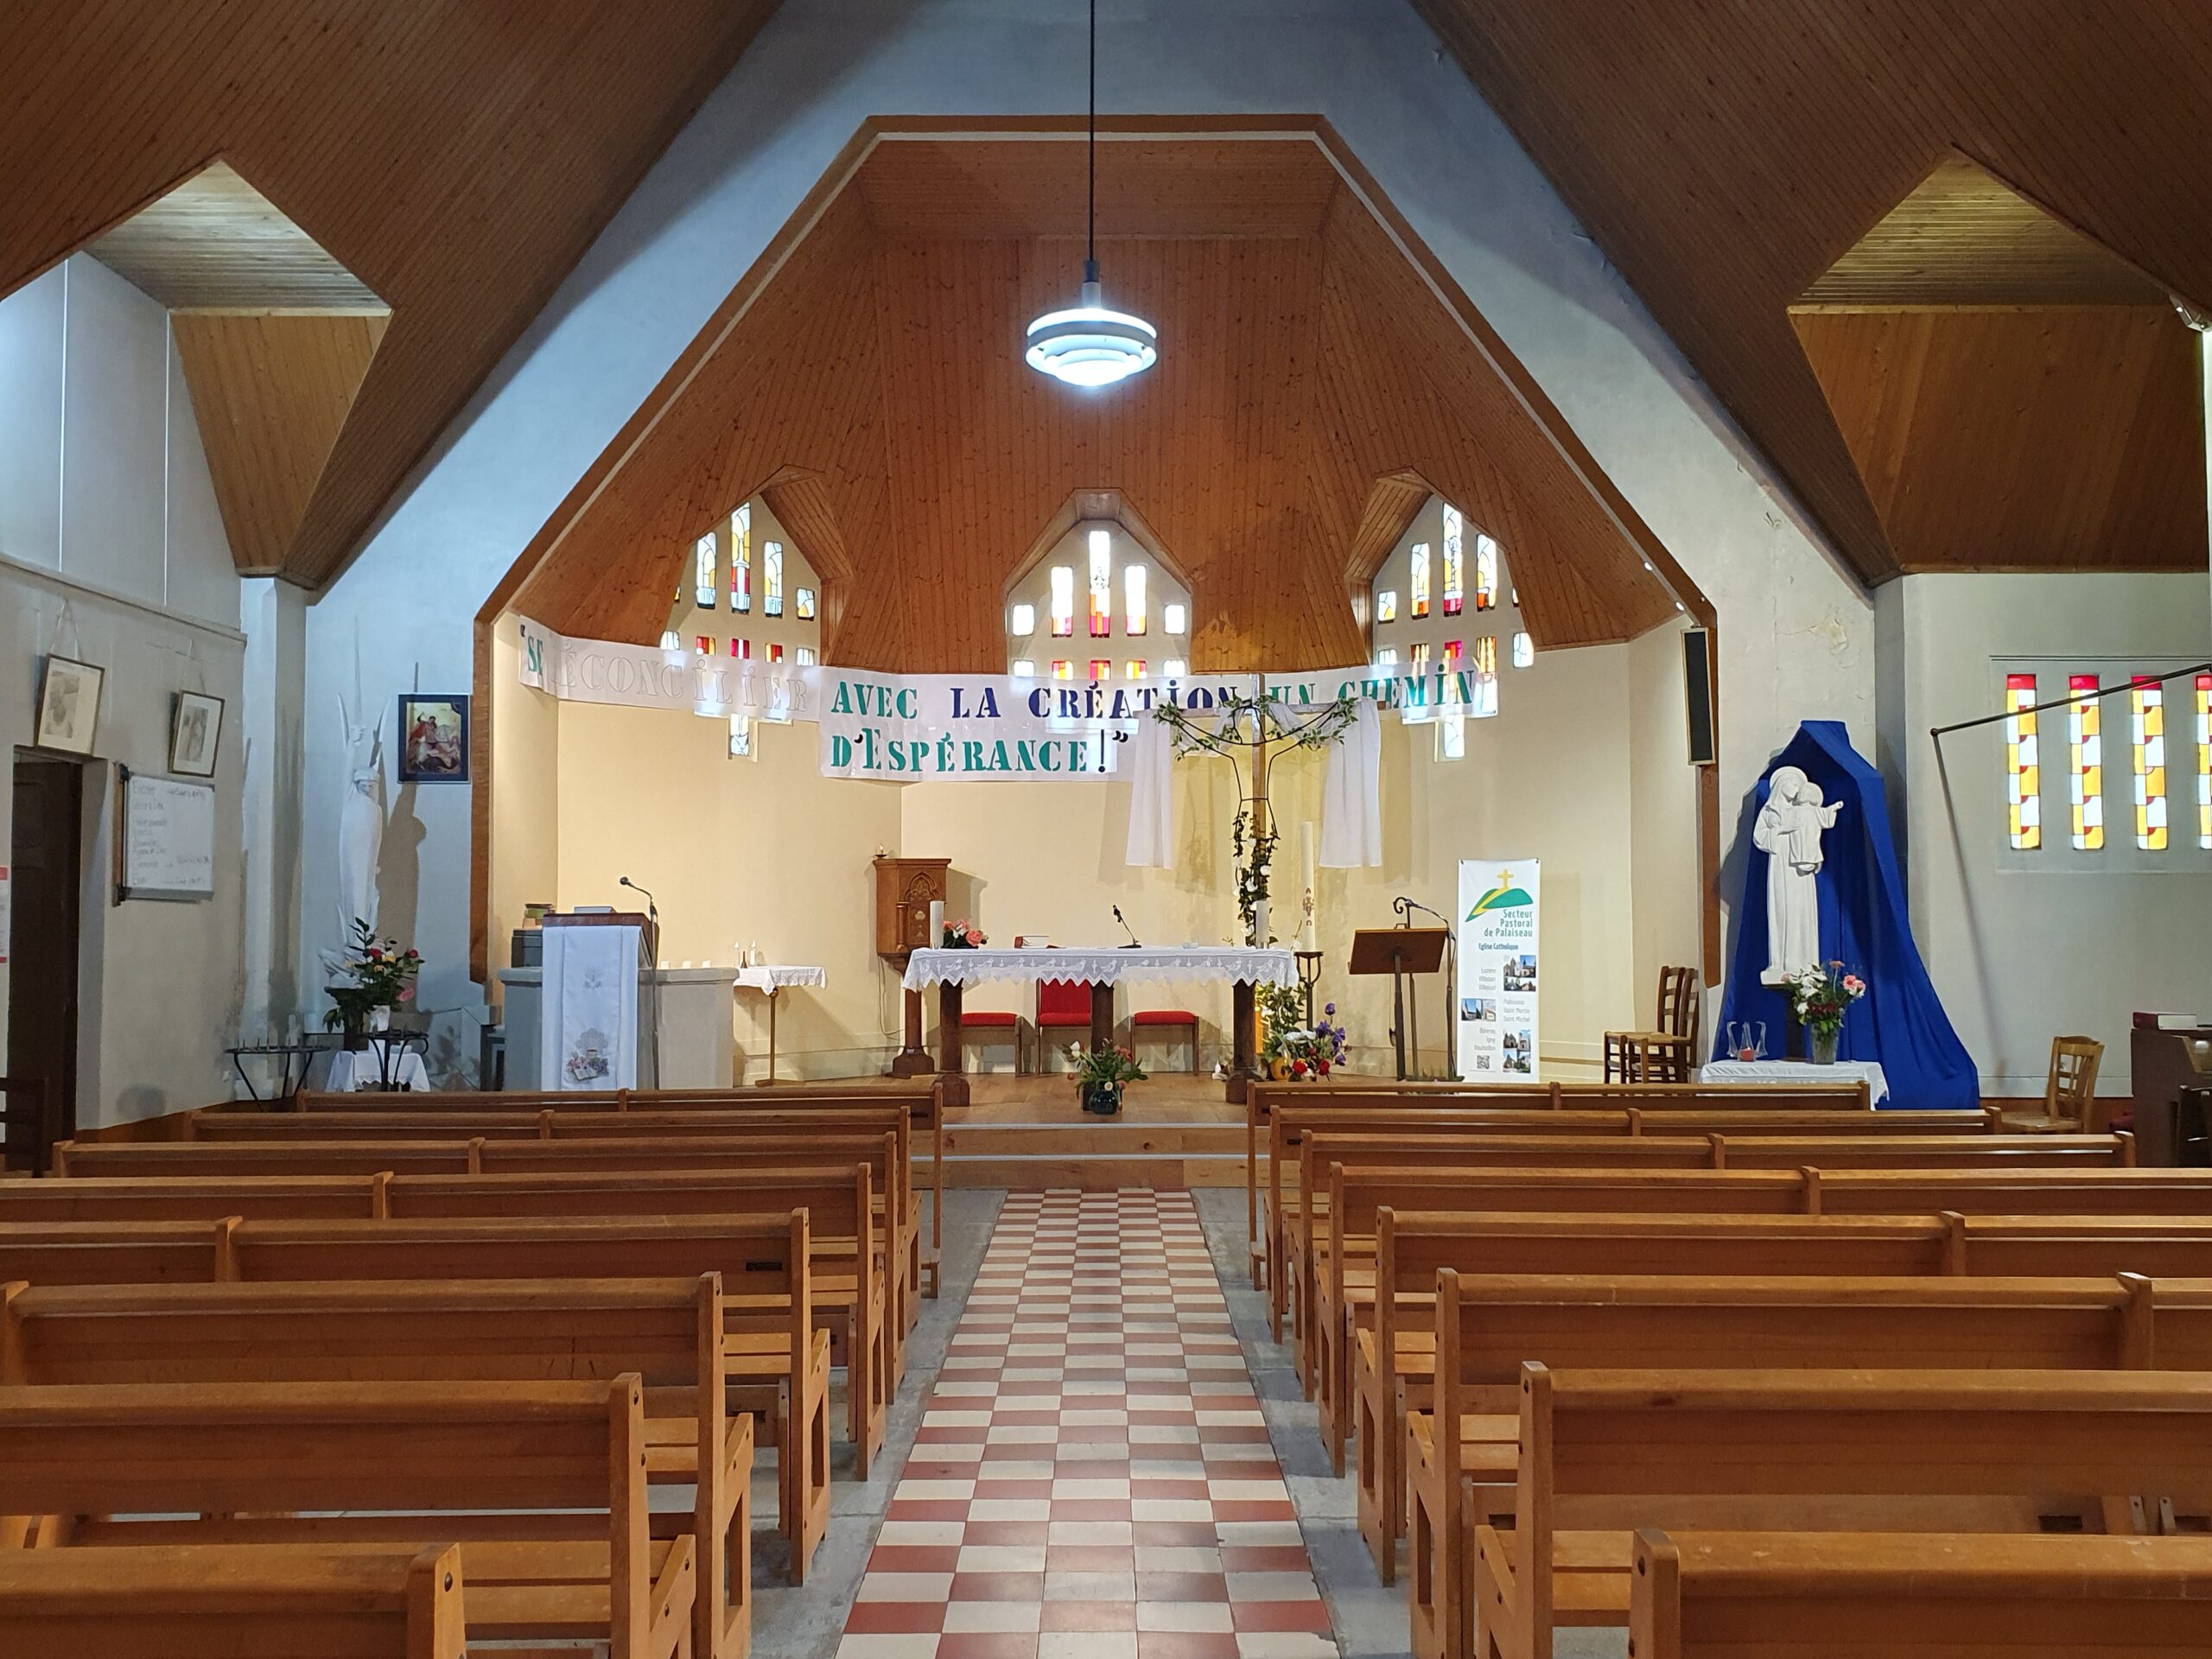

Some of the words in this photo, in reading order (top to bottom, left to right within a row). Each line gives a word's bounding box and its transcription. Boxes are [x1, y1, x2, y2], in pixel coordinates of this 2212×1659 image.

[830, 680, 918, 720] AVEC
[950, 687, 1001, 719] LA
[1503, 909, 1533, 918] Secteur
[1500, 918, 1533, 928] Pastoral
[1484, 927, 1493, 937] de
[1496, 927, 1533, 937] Palaiseau
